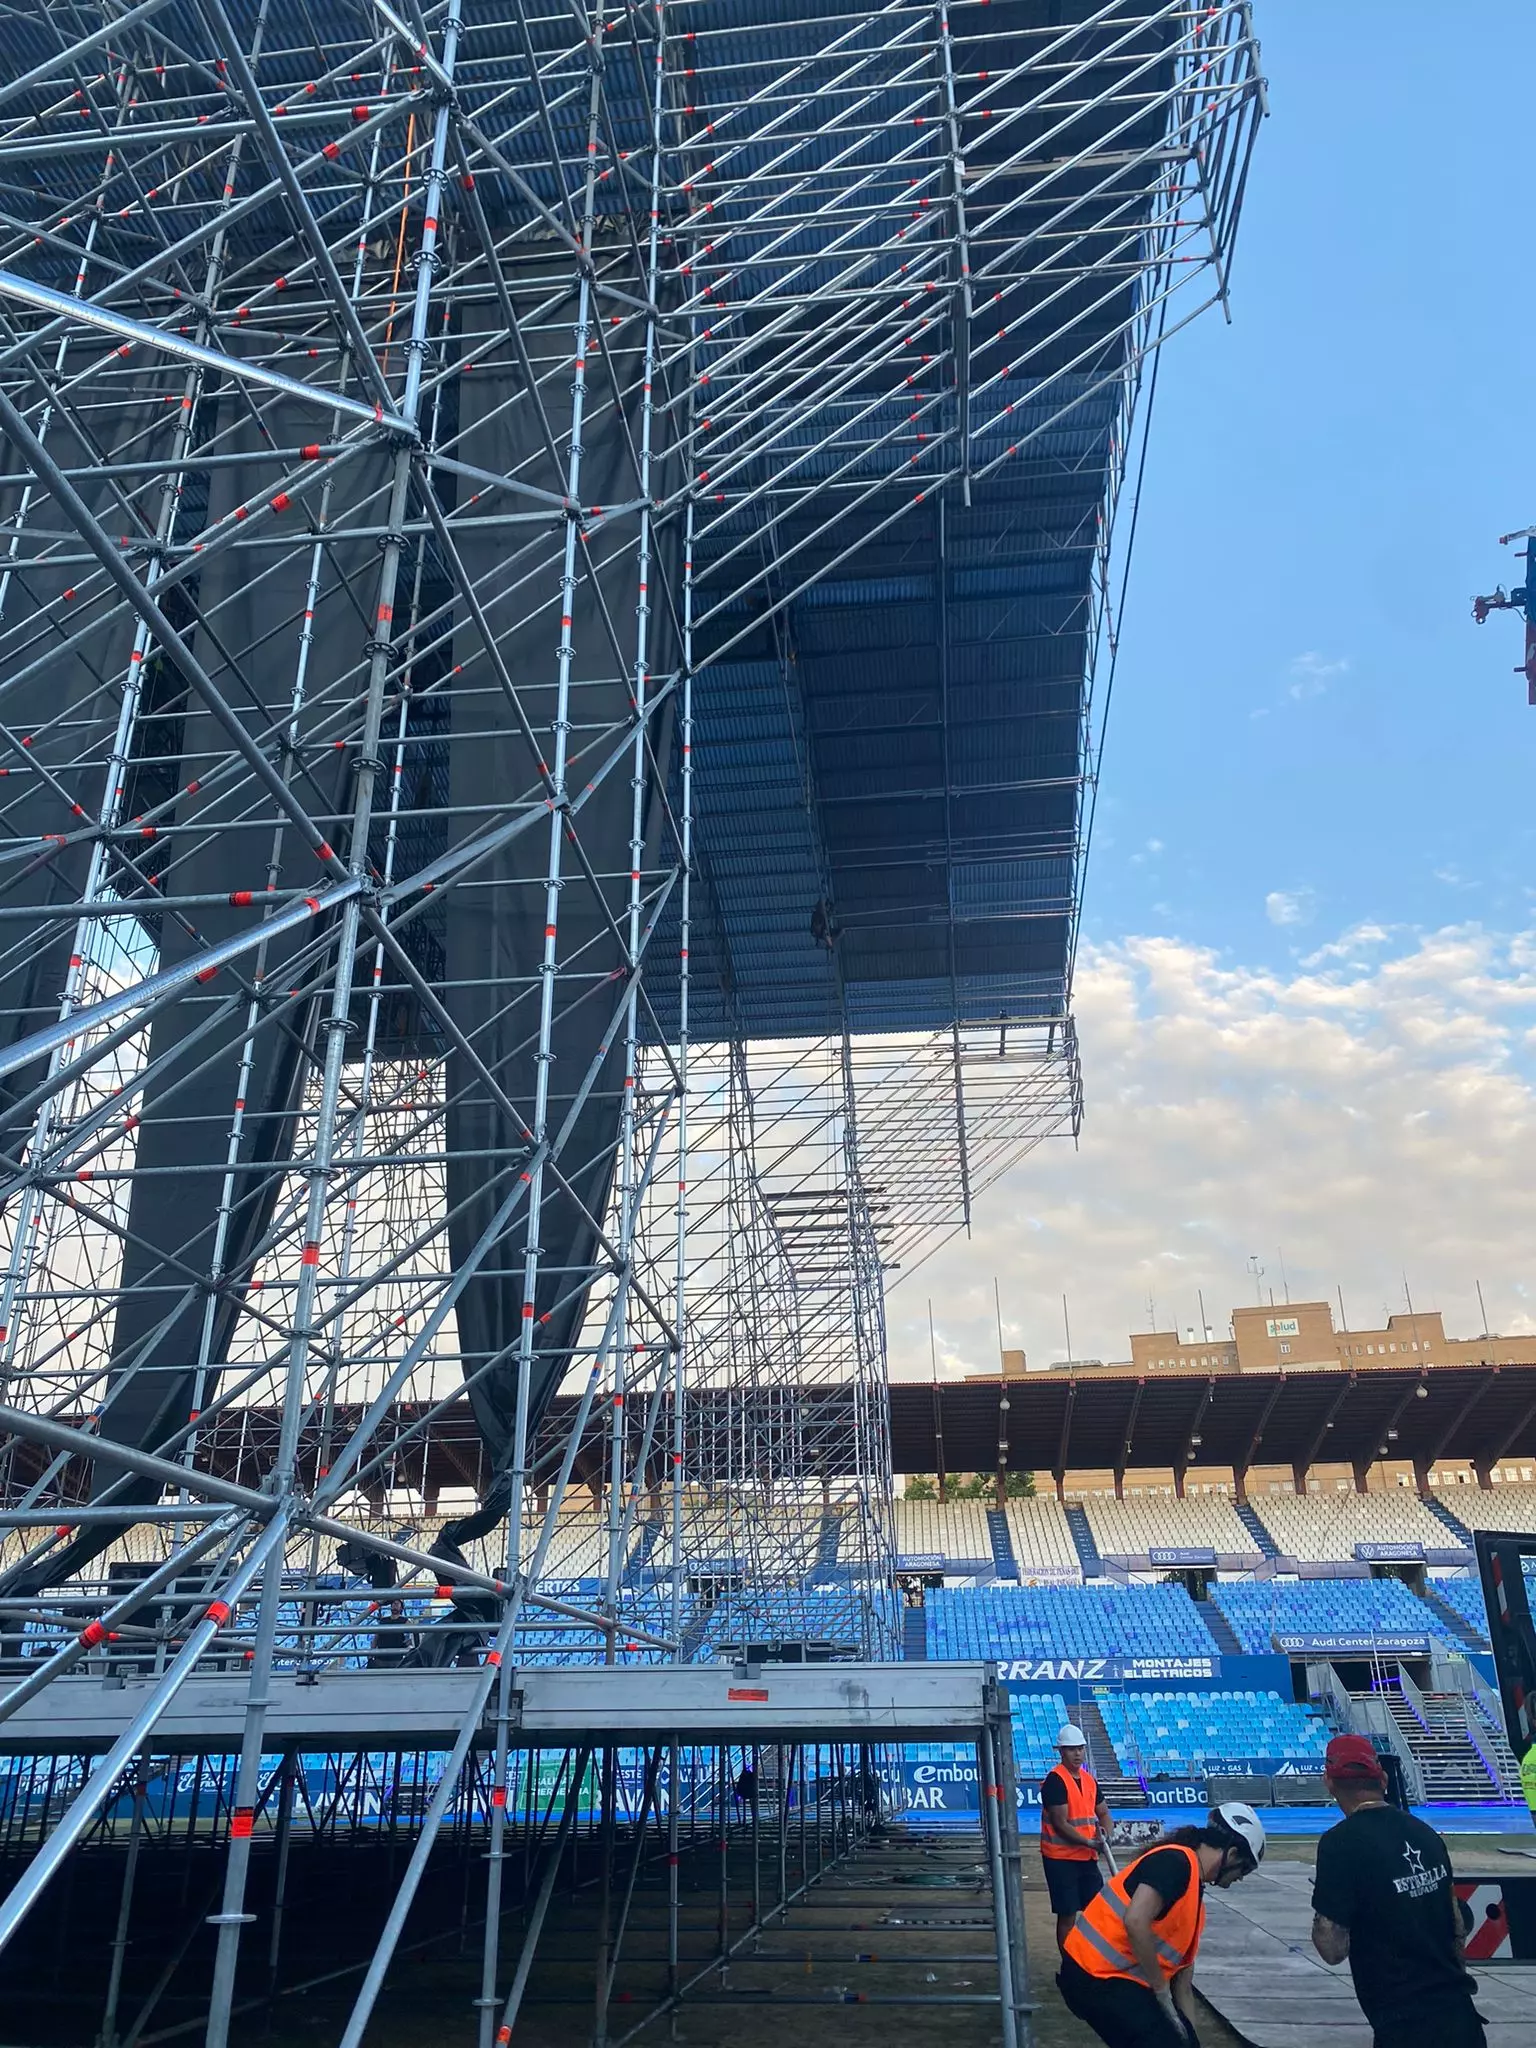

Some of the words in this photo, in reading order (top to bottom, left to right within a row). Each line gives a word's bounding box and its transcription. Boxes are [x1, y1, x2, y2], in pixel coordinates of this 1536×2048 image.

[1311, 1637, 1337, 1647] Audi
[1338, 1637, 1374, 1647] Center
[1376, 1637, 1426, 1648] Zaragoza
[1132, 1658, 1212, 1668] MONTAJES
[1123, 1668, 1213, 1679] ELECTRICOS
[1227, 1764, 1242, 1772] GAS
[1392, 1863, 1448, 1894] ESTRELLA
